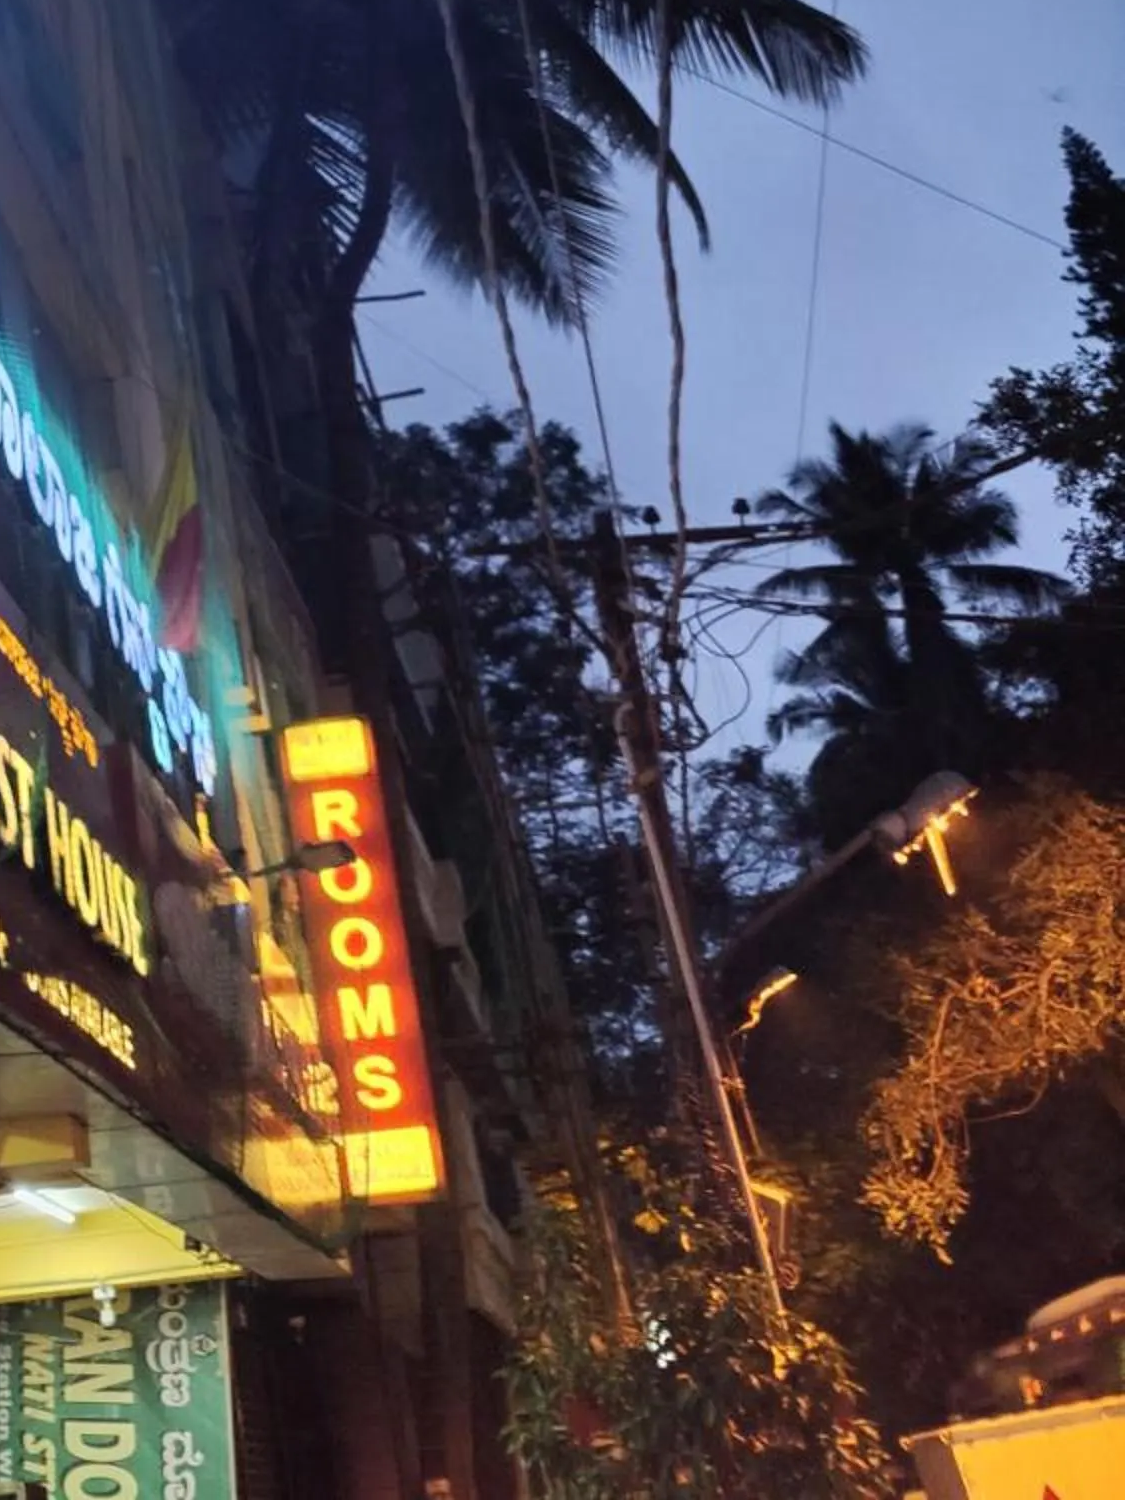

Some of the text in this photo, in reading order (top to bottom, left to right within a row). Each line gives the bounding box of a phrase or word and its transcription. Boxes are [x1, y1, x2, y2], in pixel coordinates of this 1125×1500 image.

[44, 786, 148, 976] HOUSE
[312, 788, 402, 1111] ROOMS
[21, 1331, 57, 1424] NATI
